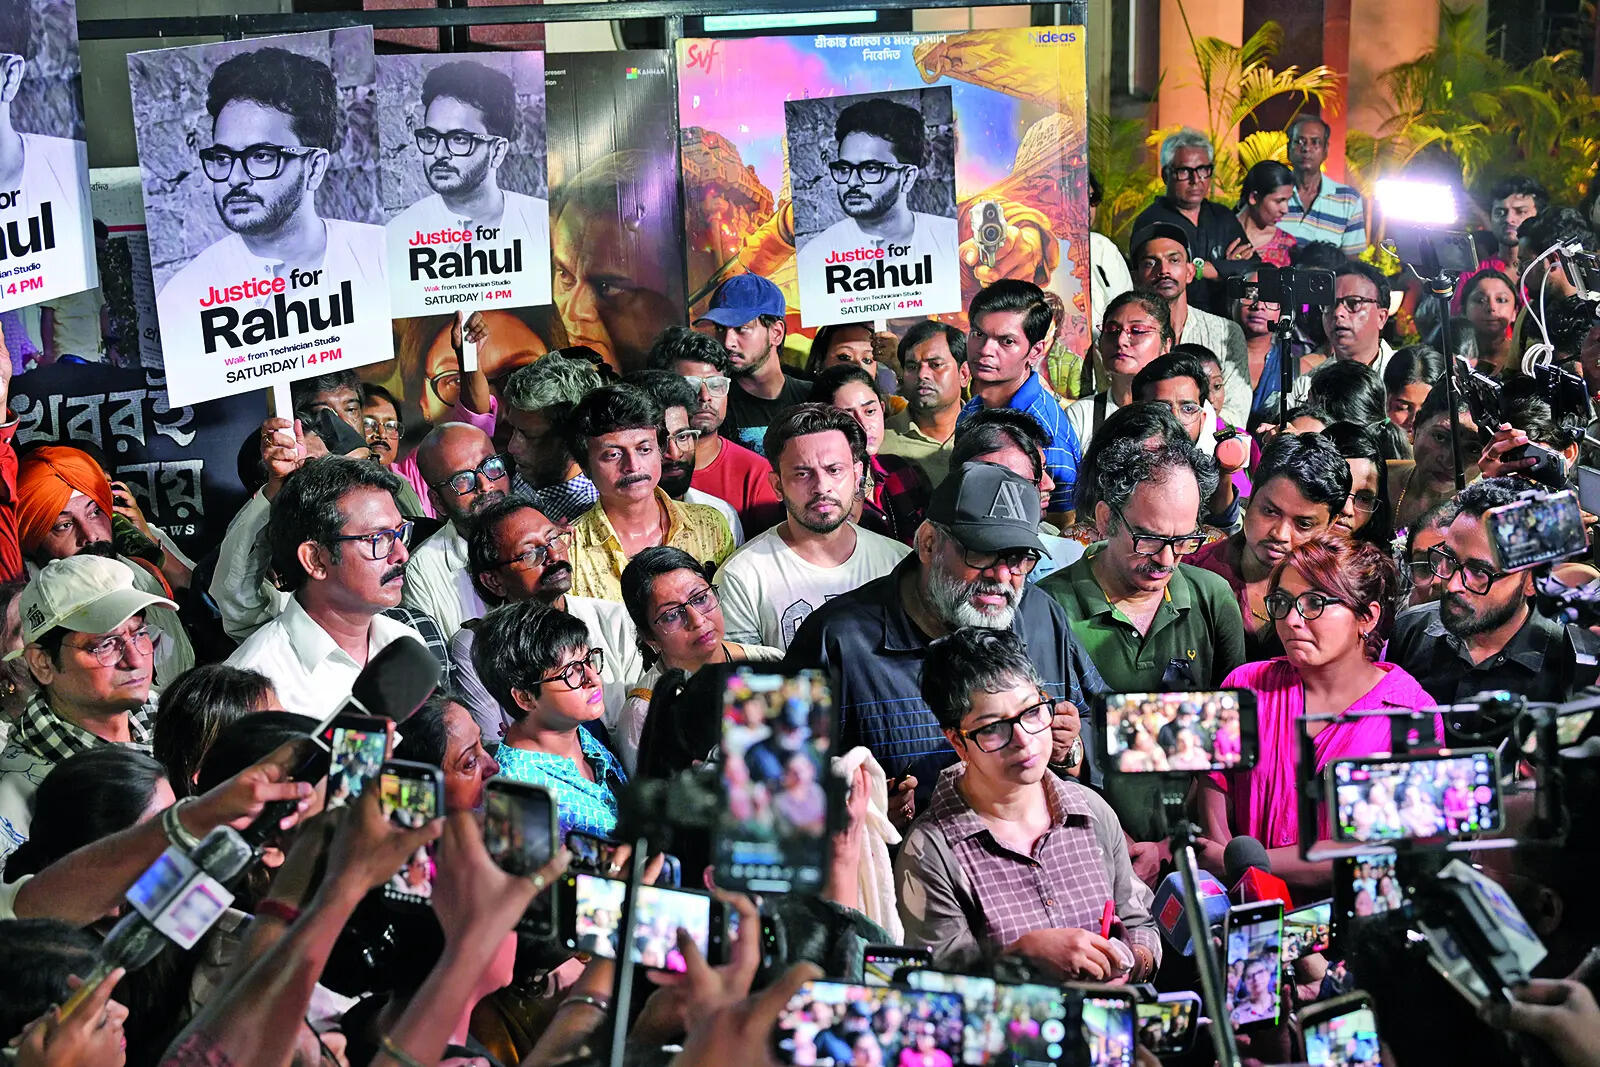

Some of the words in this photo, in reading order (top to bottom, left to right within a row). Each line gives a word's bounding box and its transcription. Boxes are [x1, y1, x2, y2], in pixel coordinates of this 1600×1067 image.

[883, 36, 891, 46] ও
[862, 48, 901, 61] নিবেদিত
[408, 228, 473, 246] Justice
[475, 225, 500, 240] for
[409, 239, 522, 281] Rahul
[825, 247, 884, 264] Justice
[887, 243, 911, 257] for
[13, 262, 41, 275] Studio
[825, 254, 932, 294] Rahul
[7, 282, 17, 294] 4
[20, 275, 43, 292] PM
[200, 277, 285, 307] Justice
[290, 268, 322, 290] for
[458, 281, 490, 289] Technician
[491, 279, 511, 287] Studio
[424, 293, 479, 306] SATURDAY
[485, 291, 493, 300] 4
[495, 289, 512, 300] PM
[871, 292, 902, 300] Technician
[200, 280, 354, 354] Rahul
[841, 302, 891, 315] SATURDAY
[897, 301, 904, 309] 4
[907, 299, 923, 308] PM
[224, 355, 246, 366] Walk
[247, 350, 268, 361] from
[269, 341, 313, 356] Technician
[314, 335, 340, 347] Studio
[226, 357, 298, 383] SATURDAY
[307, 353, 317, 365] 4
[320, 348, 342, 363] PM
